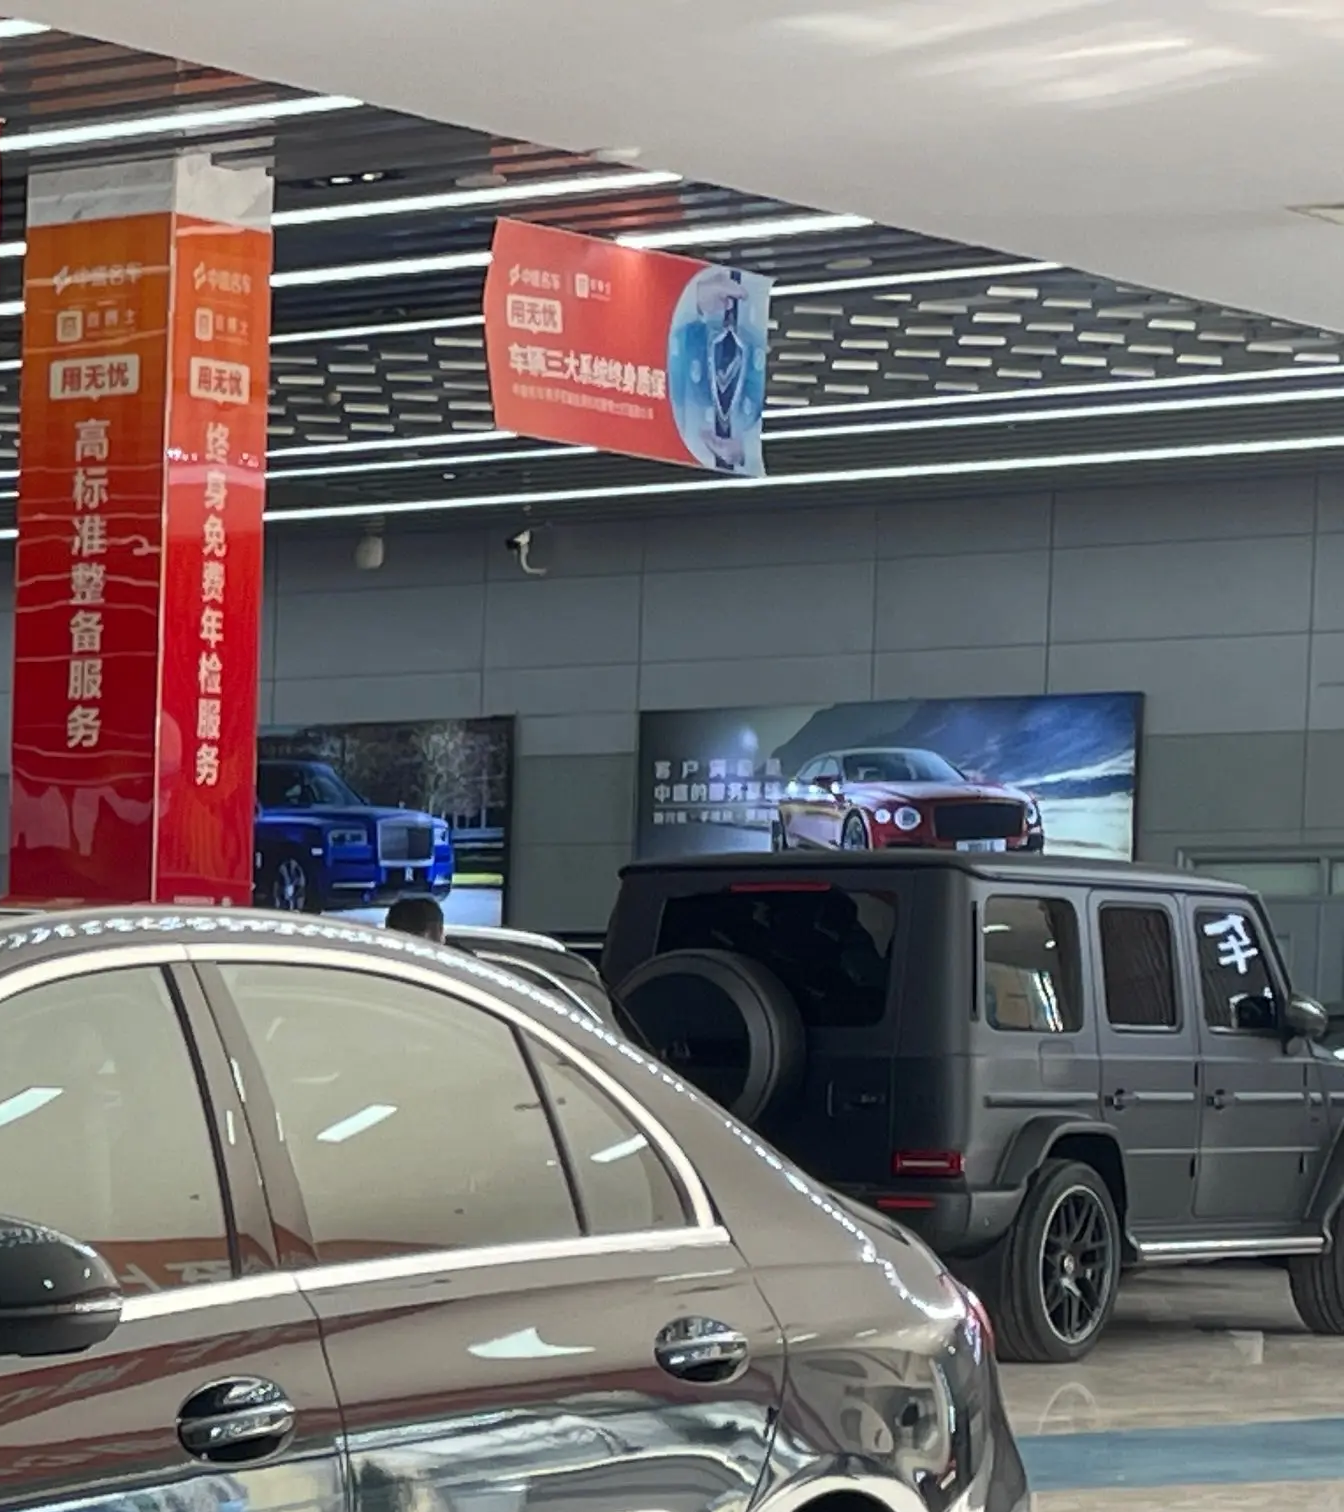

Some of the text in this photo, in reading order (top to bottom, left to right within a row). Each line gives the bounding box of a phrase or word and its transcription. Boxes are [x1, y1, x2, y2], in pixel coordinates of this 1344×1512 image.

[511, 299, 559, 328] 用无忧
[60, 361, 129, 393] 用无忧
[197, 366, 243, 397] 用无忧
[66, 418, 111, 748] 高标准整备服务
[195, 421, 231, 786] 终身免费年检服务
